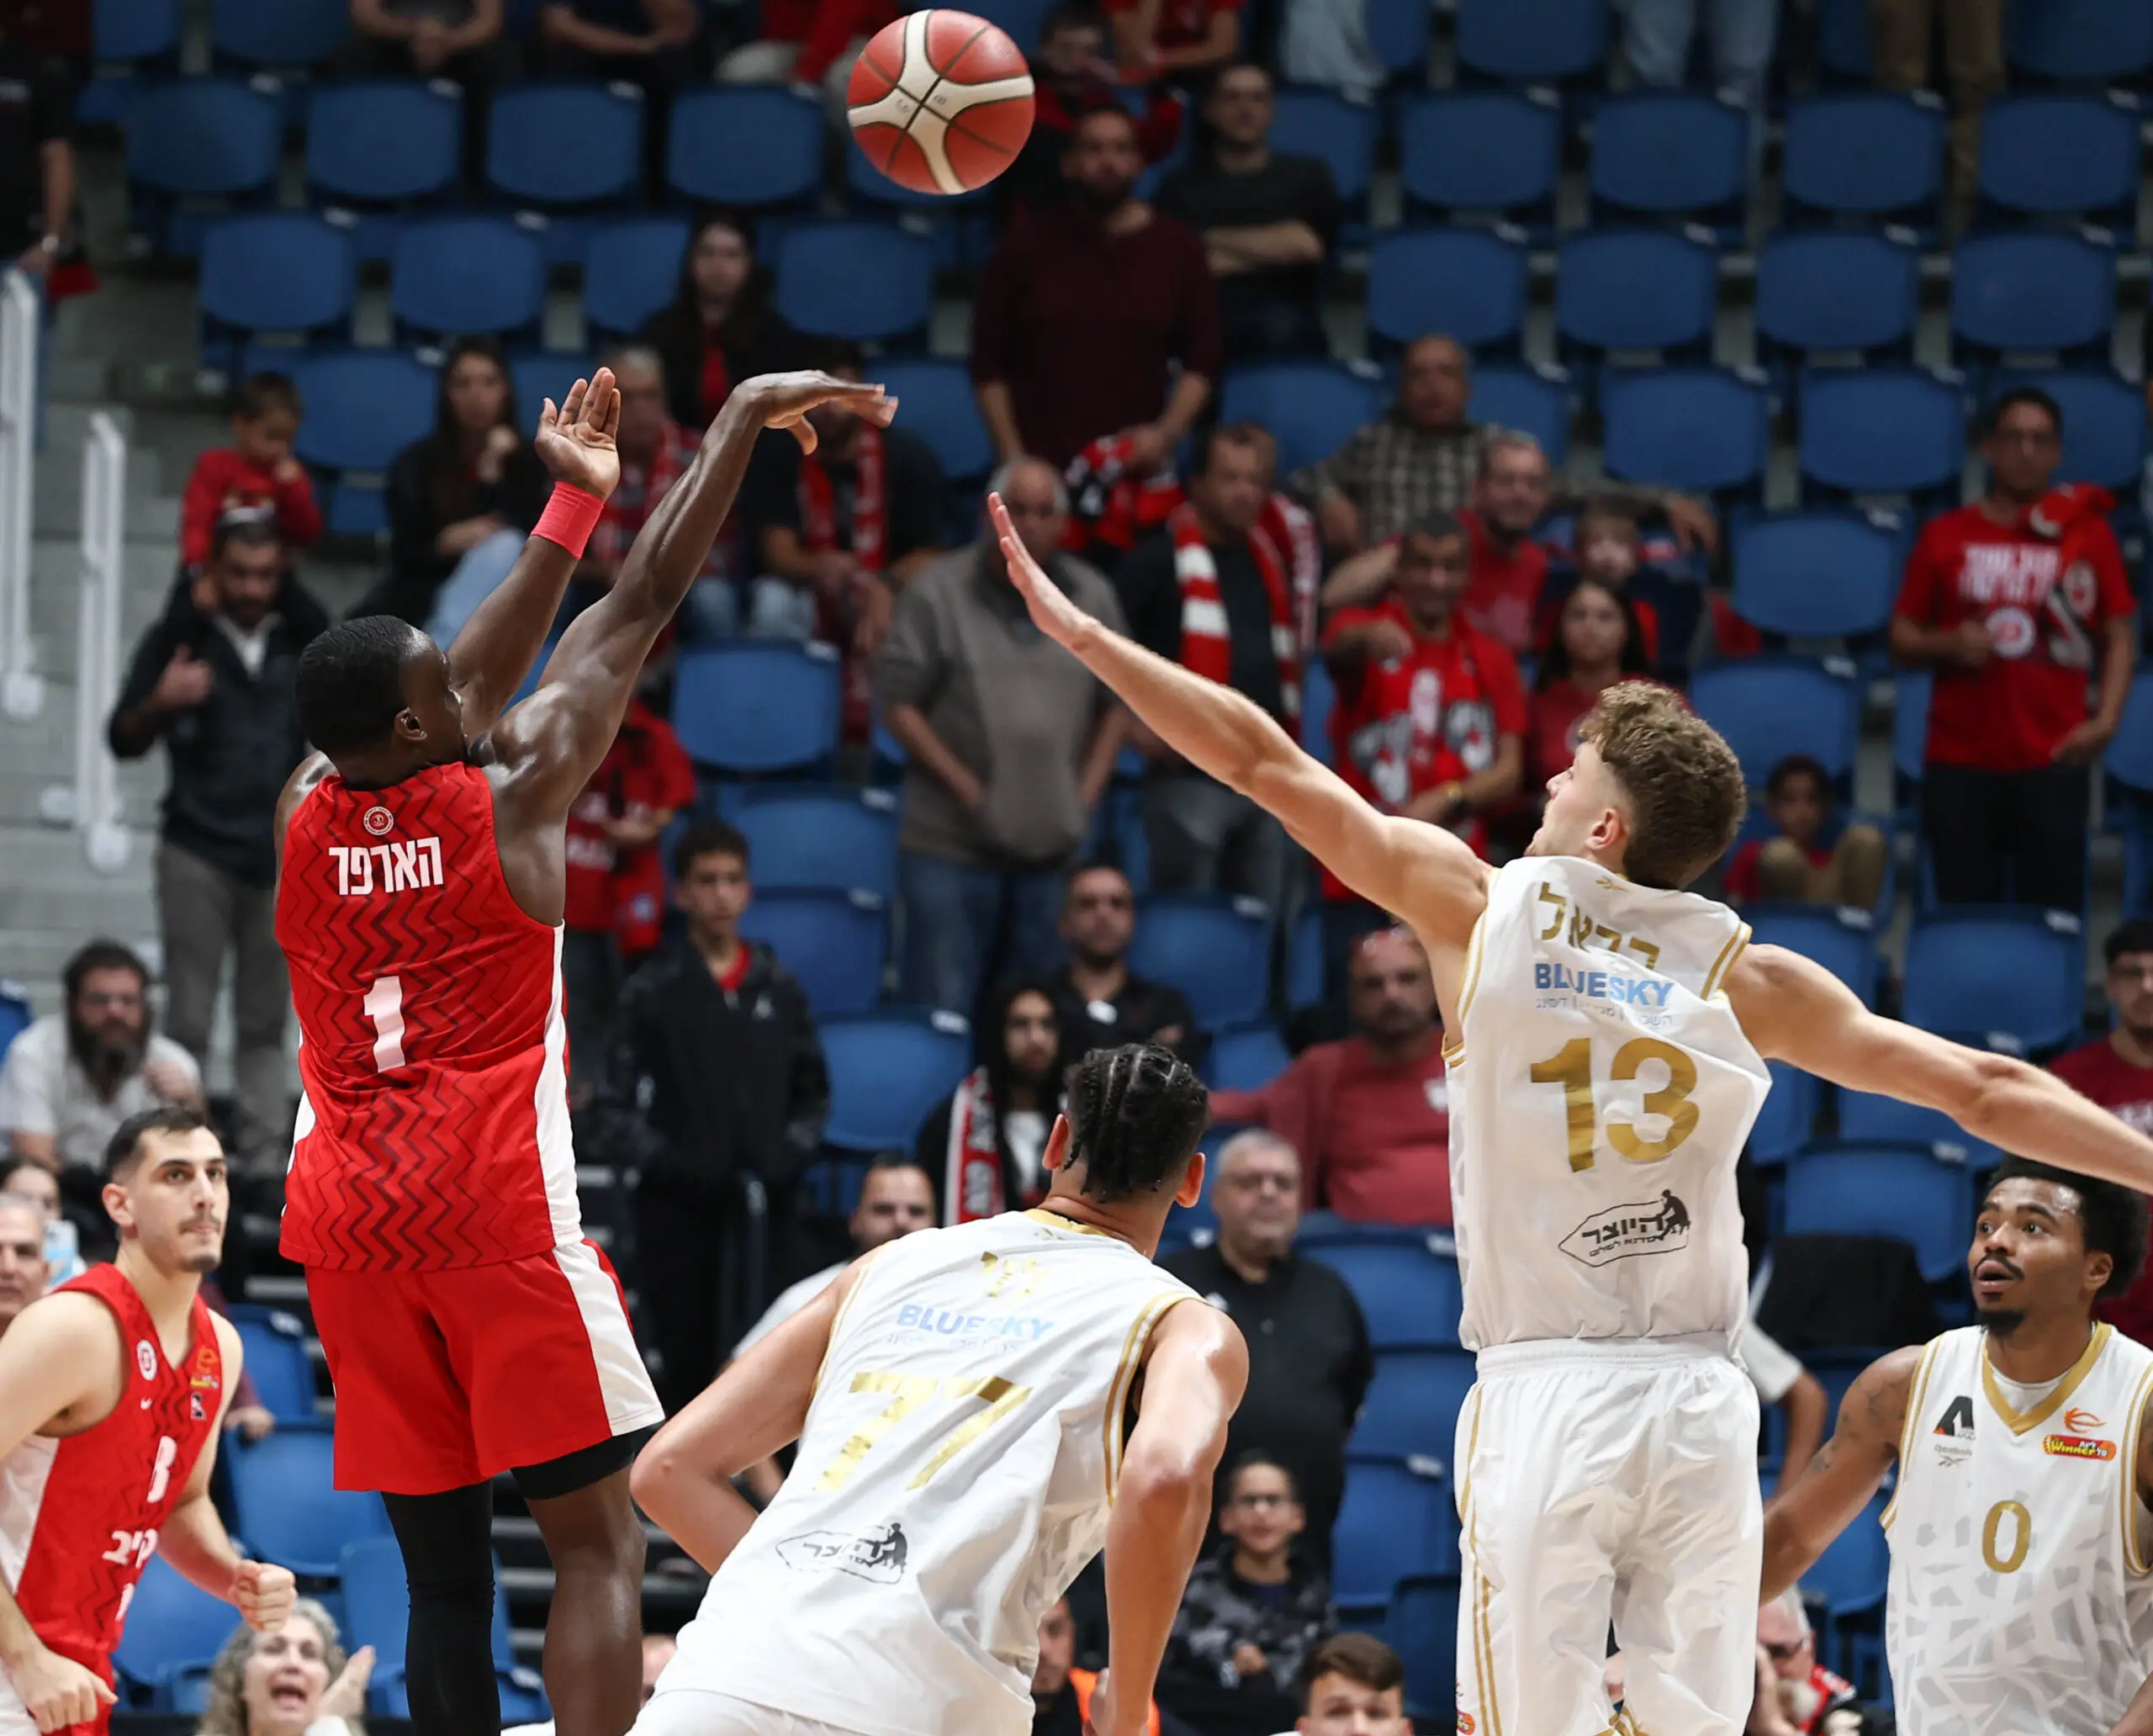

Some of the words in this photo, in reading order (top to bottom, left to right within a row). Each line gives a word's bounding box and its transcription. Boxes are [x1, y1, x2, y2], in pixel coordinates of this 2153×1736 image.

[329, 836, 444, 896] הארפר
[1535, 963, 1675, 1007] BLUESKY
[363, 976, 405, 1073] 1
[1531, 1037, 1700, 1173] 13
[1582, 1216, 1664, 1245] היוצר
[812, 1372, 1034, 1492] 77
[2050, 1439, 2096, 1456] Winner
[1981, 1500, 2032, 1574] 0
